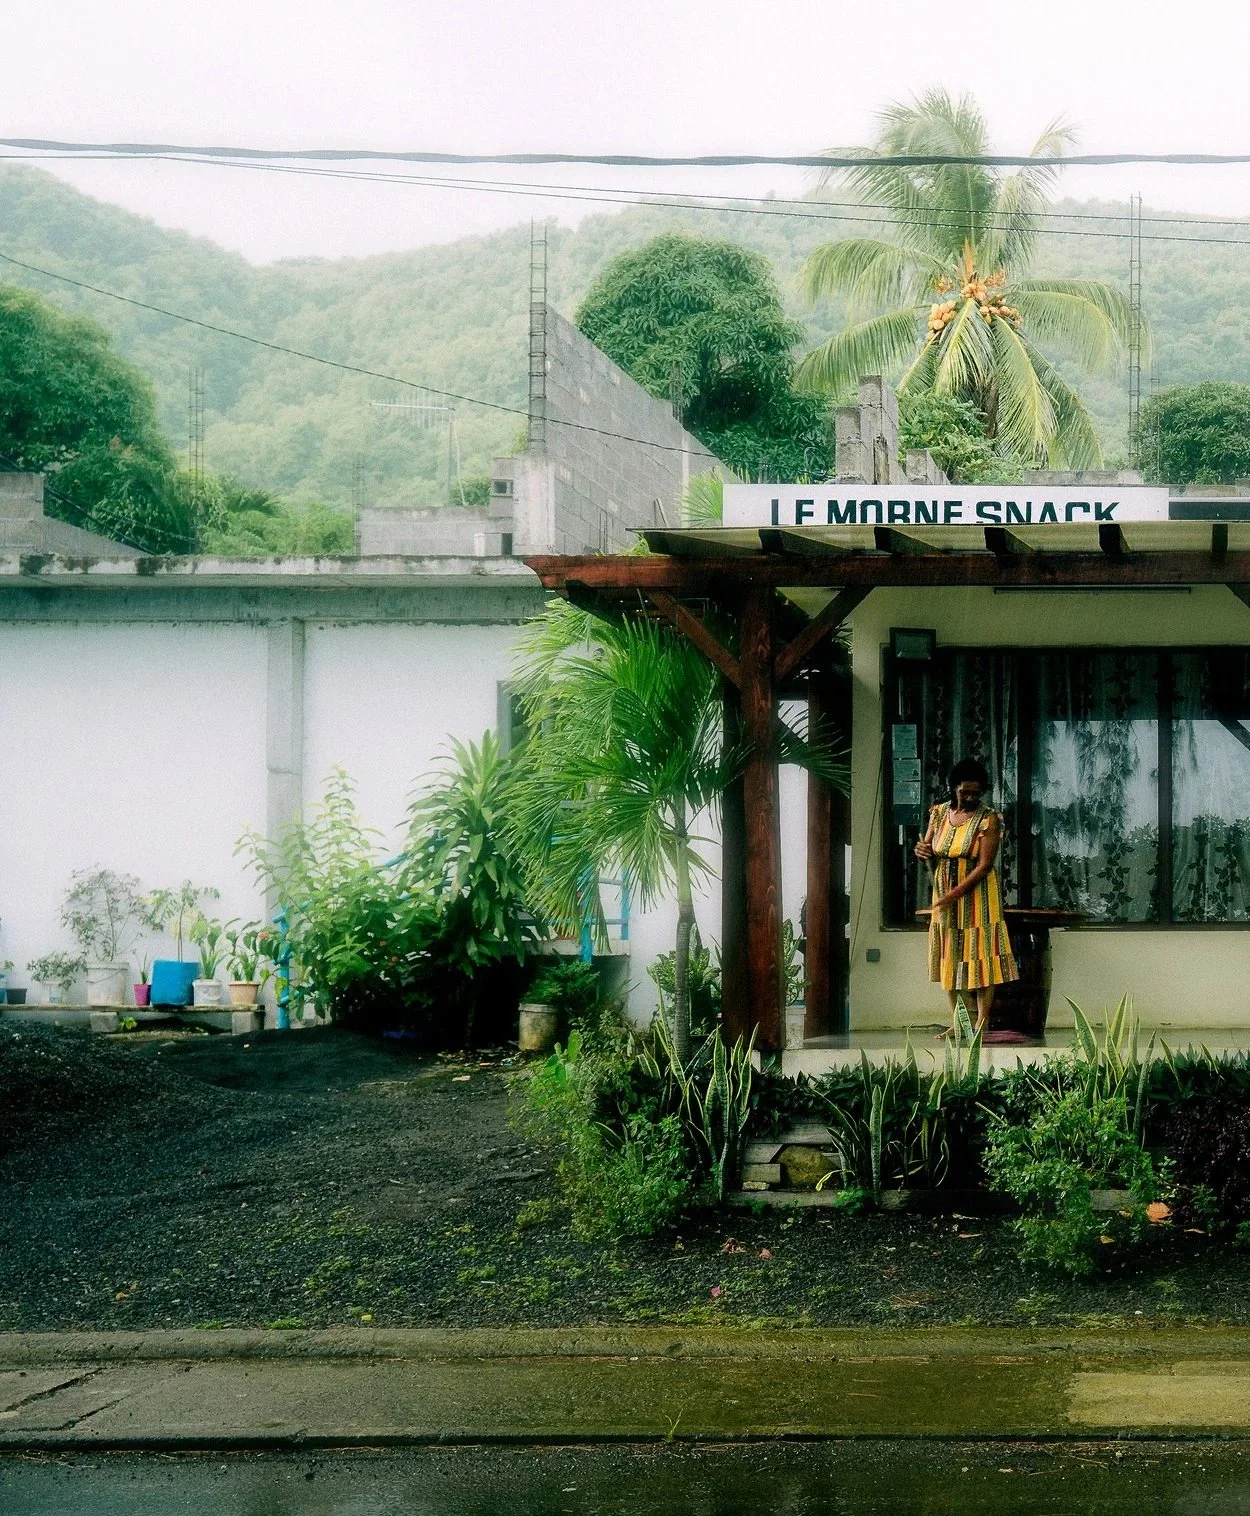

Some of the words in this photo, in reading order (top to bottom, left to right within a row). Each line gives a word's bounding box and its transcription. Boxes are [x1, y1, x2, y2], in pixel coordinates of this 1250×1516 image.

[771, 499, 815, 526] LE
[827, 499, 963, 525] MORNE
[975, 501, 1120, 524] SNACK
